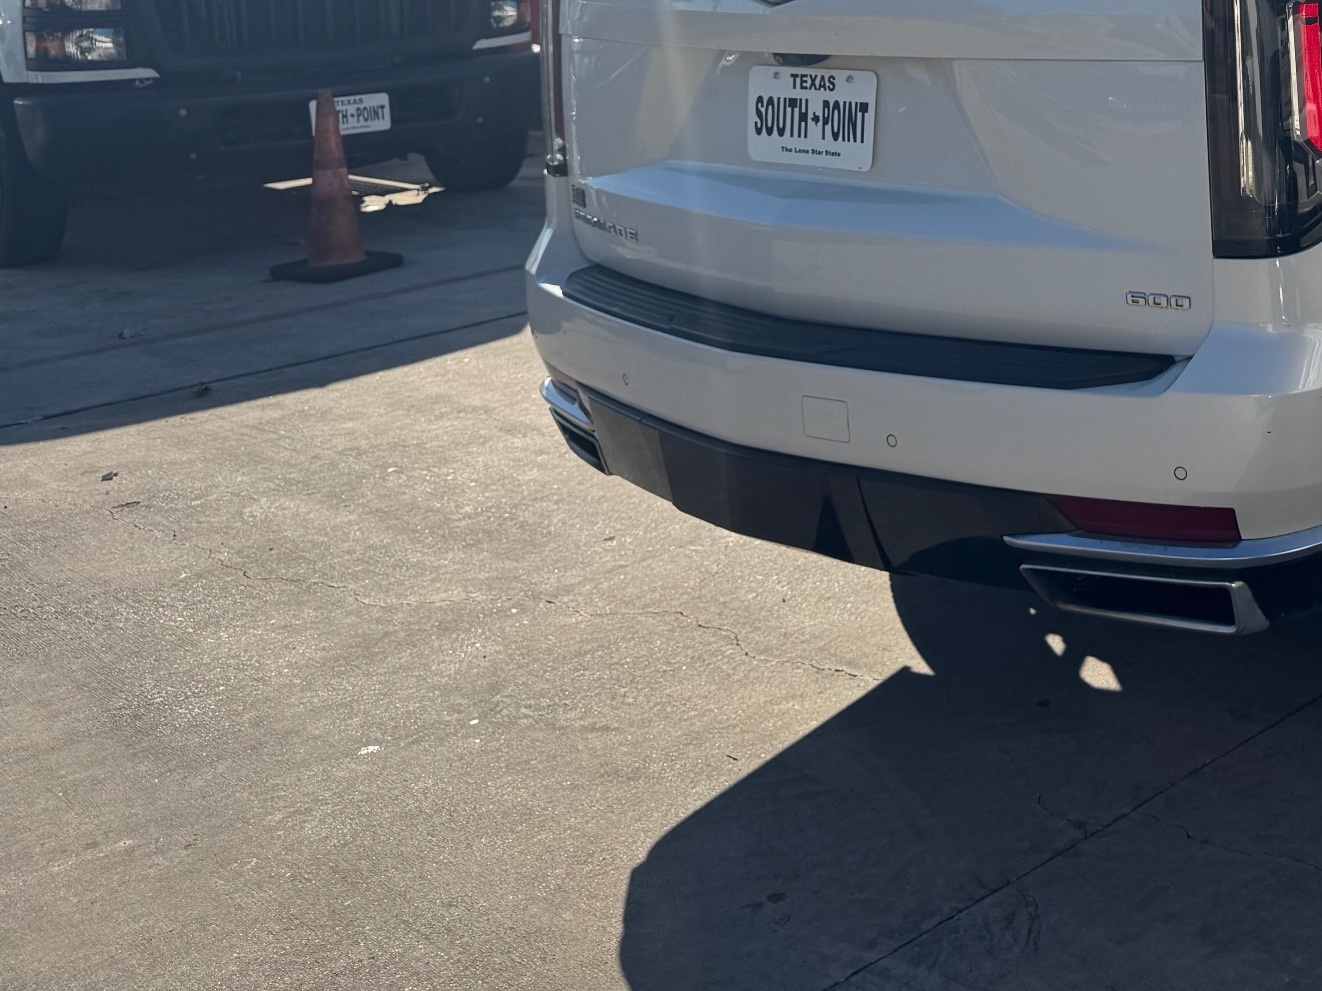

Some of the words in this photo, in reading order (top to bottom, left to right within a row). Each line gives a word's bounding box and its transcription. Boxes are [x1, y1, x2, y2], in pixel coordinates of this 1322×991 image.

[790, 73, 836, 92] TEXAS
[335, 97, 364, 107] TEXAS
[356, 105, 386, 123] POINT
[754, 95, 809, 139] SOUTH
[822, 99, 869, 144] POINT
[1125, 291, 1191, 310] 600
